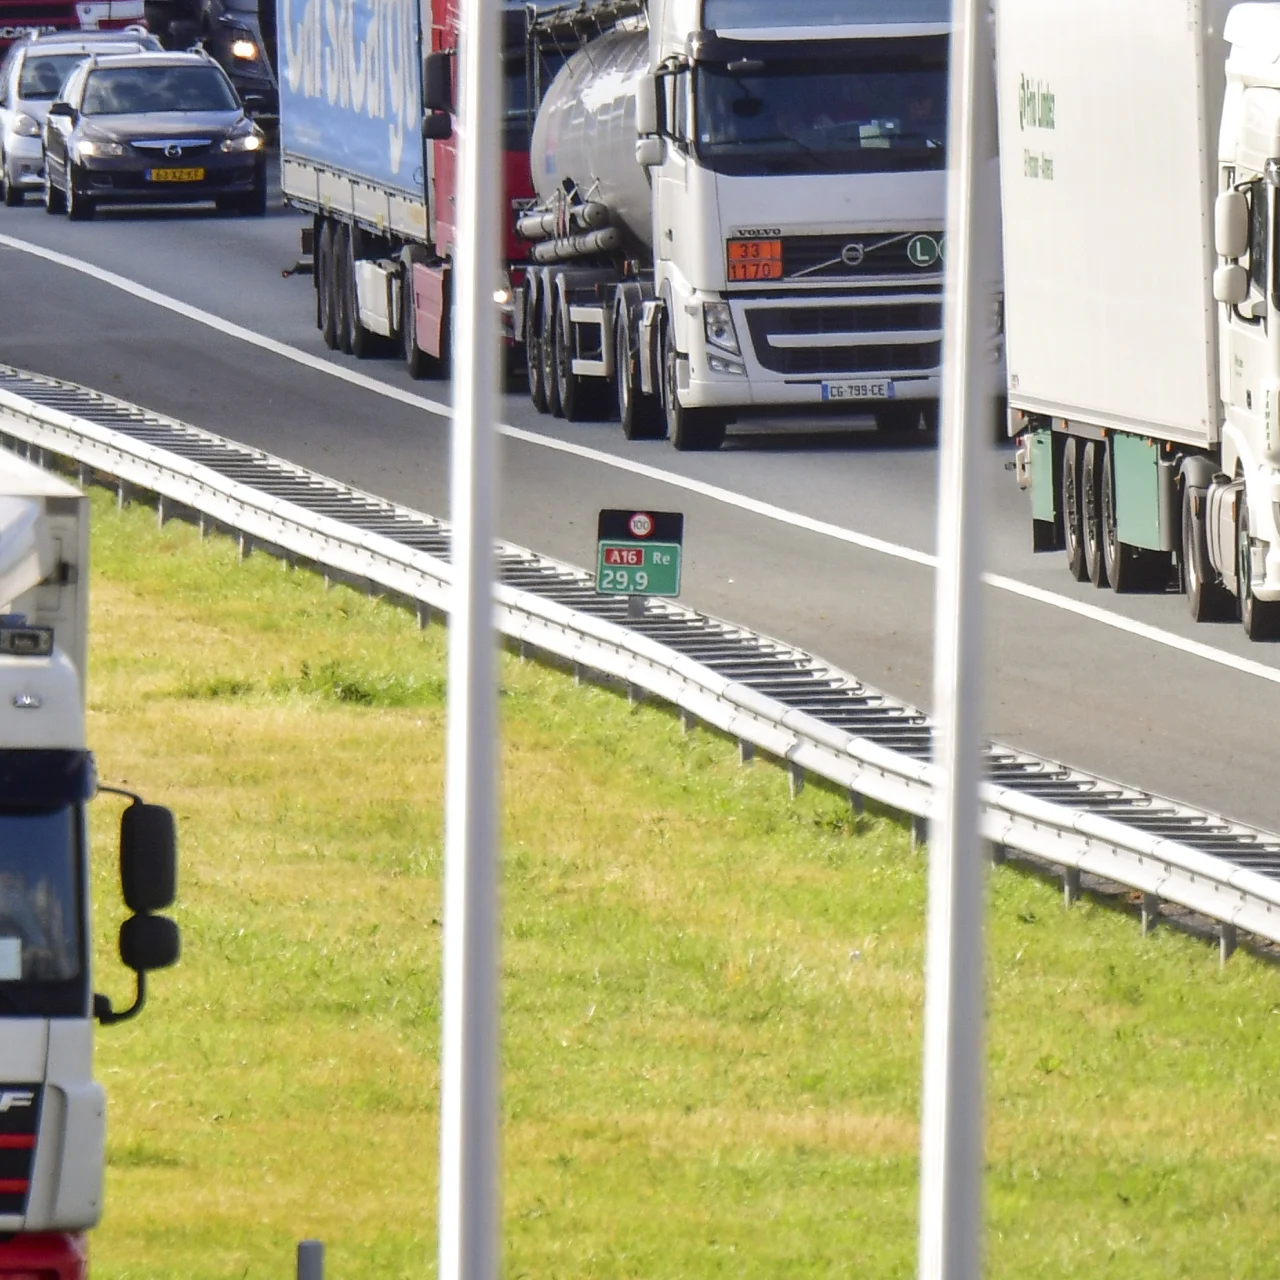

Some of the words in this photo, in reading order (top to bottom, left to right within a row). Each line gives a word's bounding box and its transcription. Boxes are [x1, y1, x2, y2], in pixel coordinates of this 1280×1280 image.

[737, 227, 781, 237] VOLVO
[739, 241, 761, 259] 33
[915, 241, 930, 261] L
[730, 262, 771, 280] 1170
[632, 519, 651, 531] 100
[610, 550, 638, 564] A16
[652, 551, 671, 566] Re
[602, 569, 649, 592] 29,9
